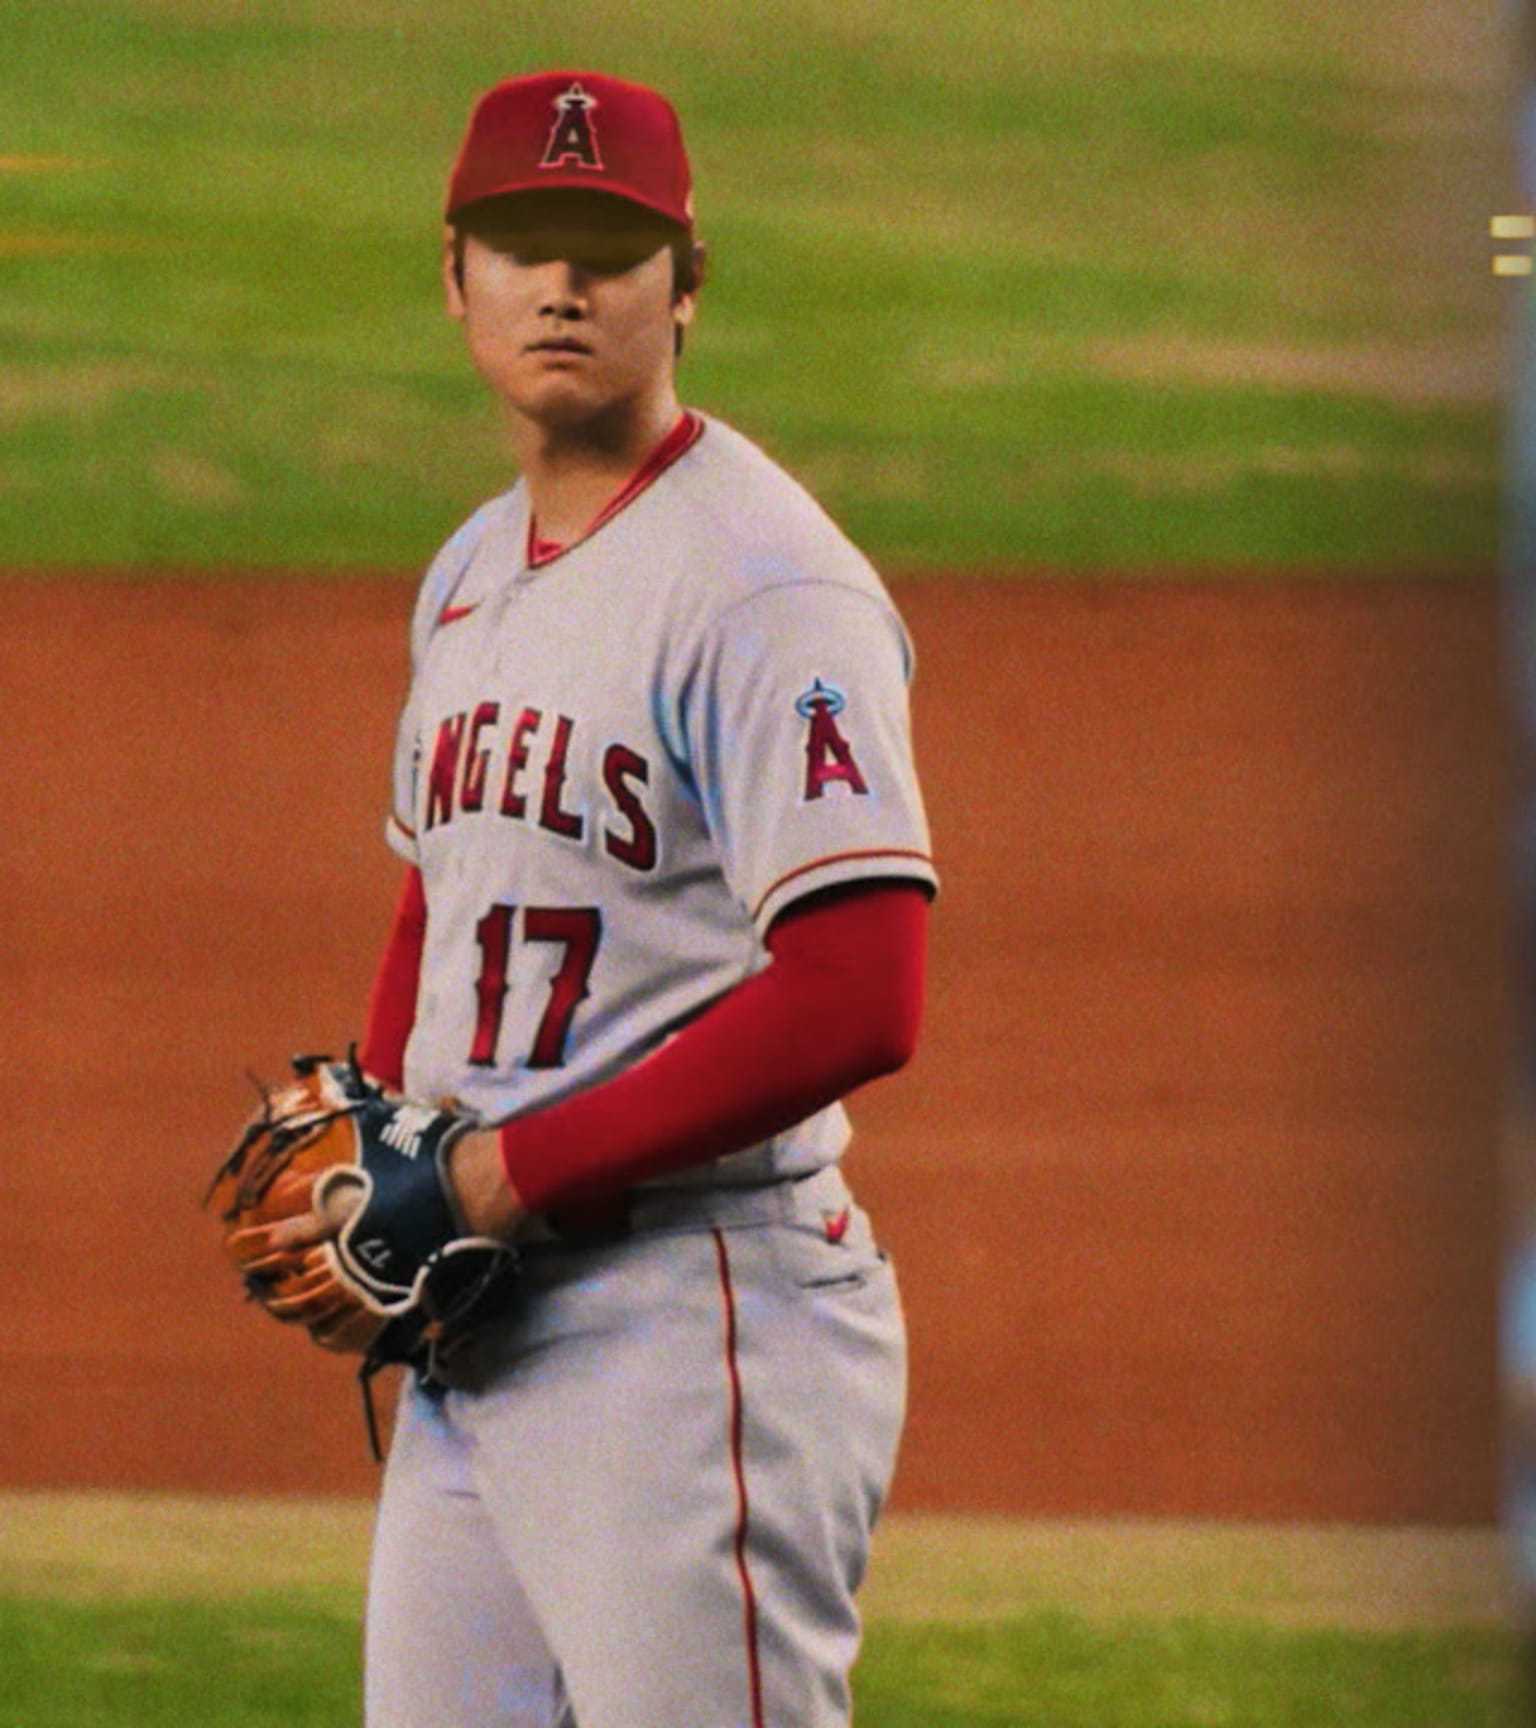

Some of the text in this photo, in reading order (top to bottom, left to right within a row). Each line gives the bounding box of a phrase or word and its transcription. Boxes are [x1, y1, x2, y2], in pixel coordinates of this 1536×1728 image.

[540, 81, 604, 170] A
[412, 702, 658, 872] NGELS
[796, 677, 870, 801] A
[468, 903, 602, 1069] 17
